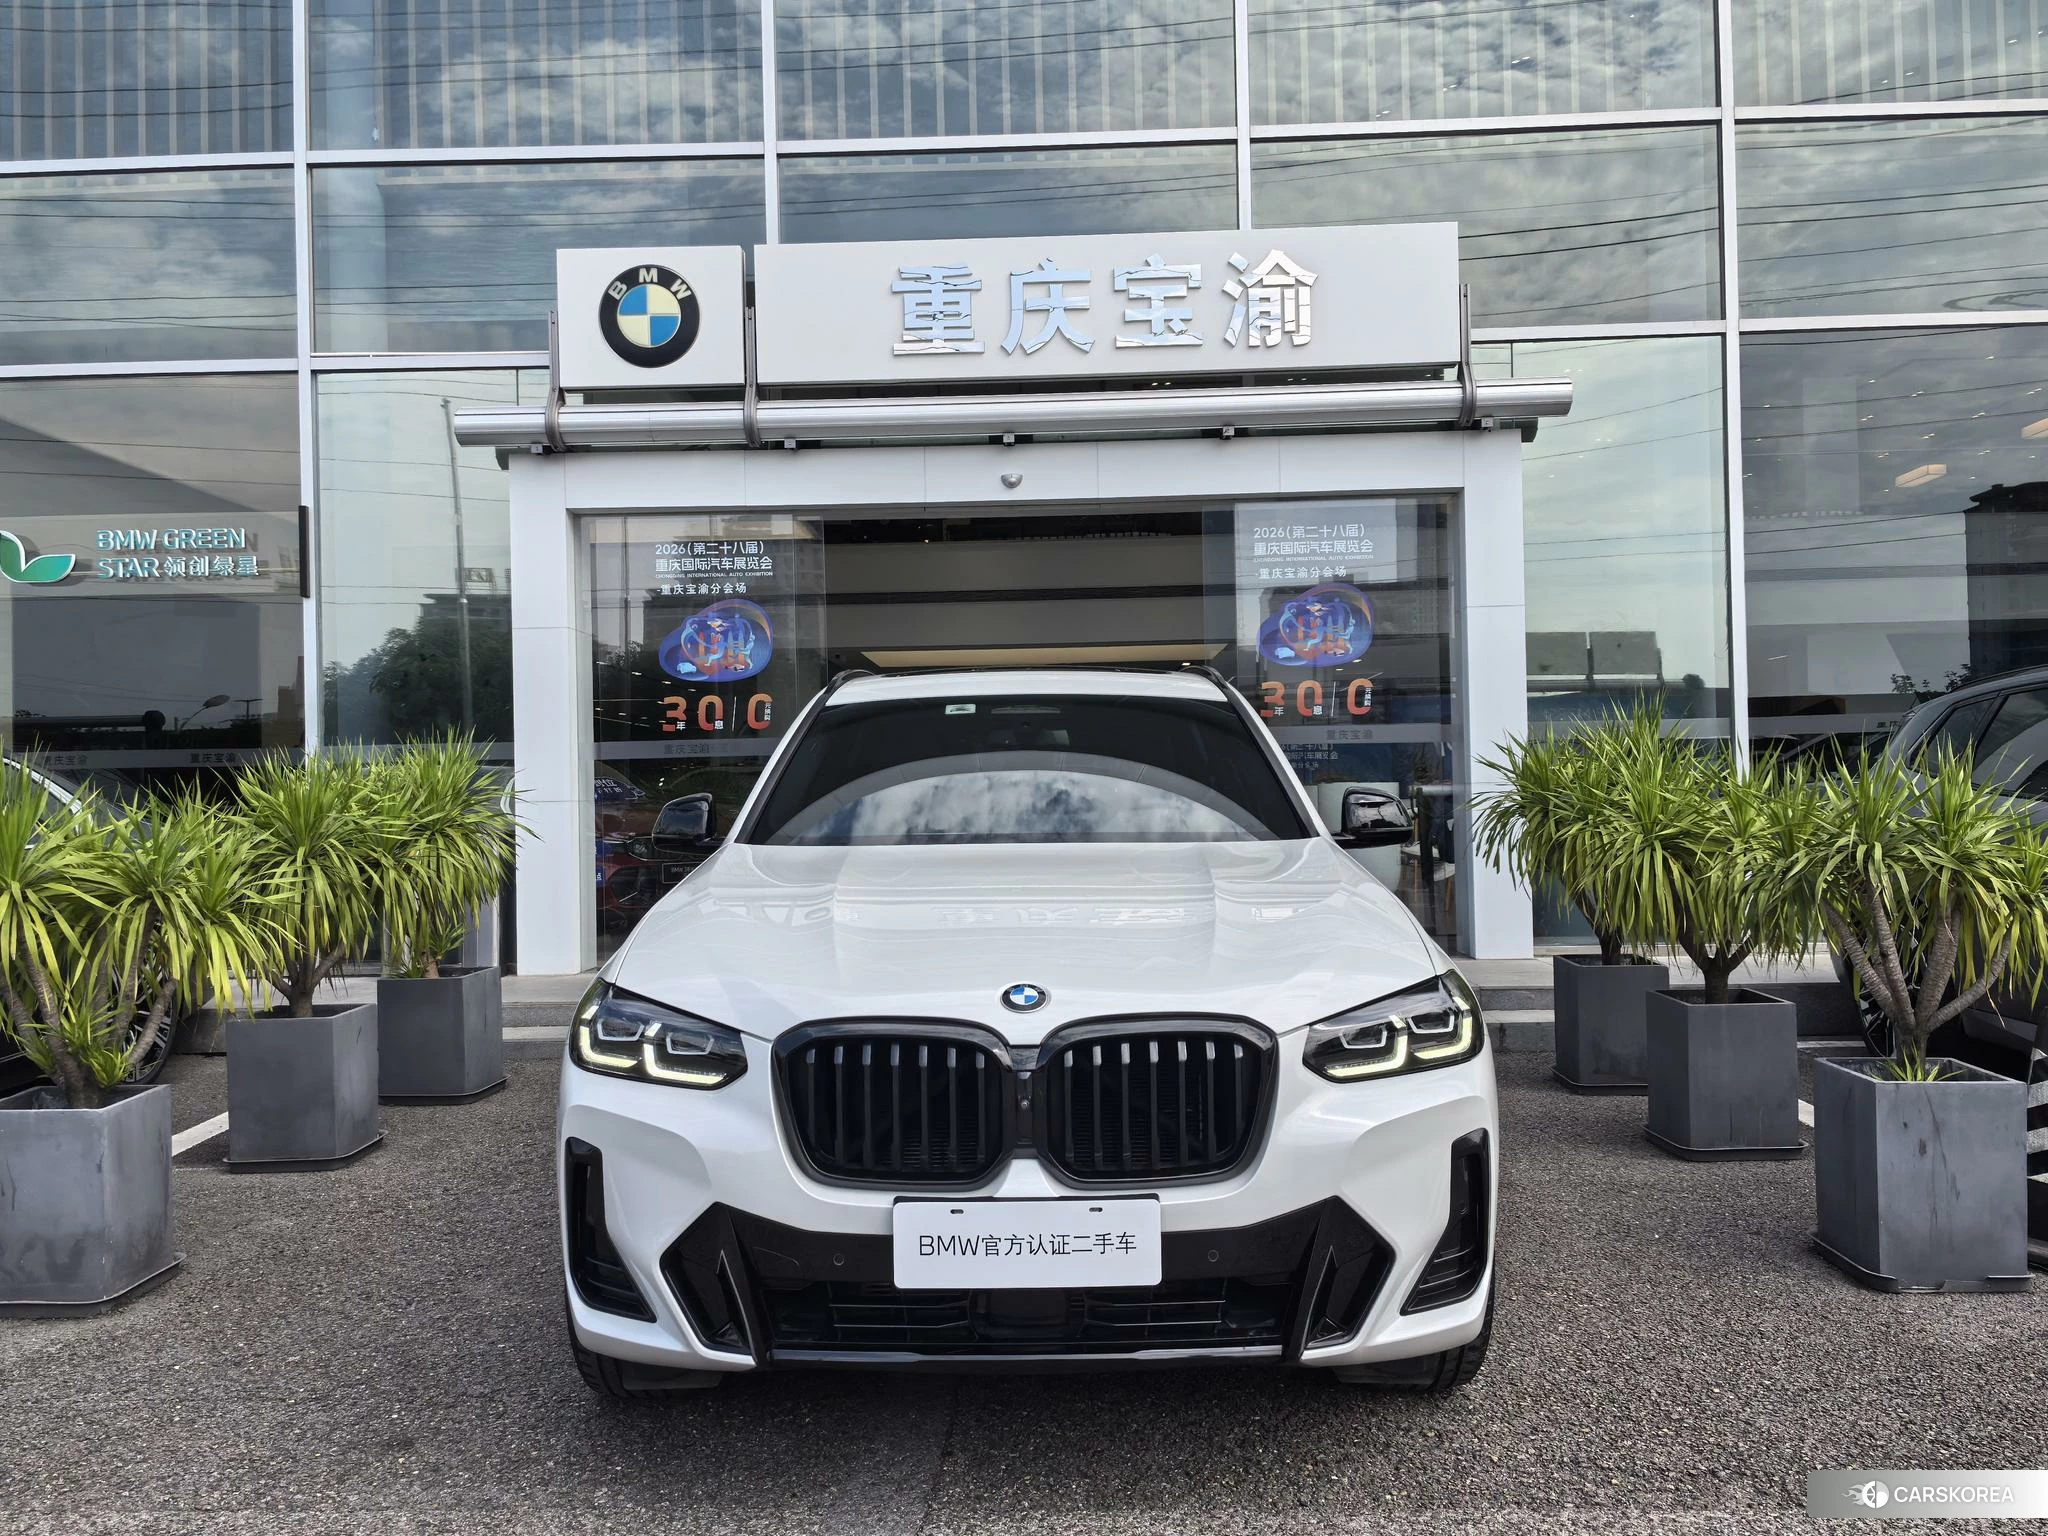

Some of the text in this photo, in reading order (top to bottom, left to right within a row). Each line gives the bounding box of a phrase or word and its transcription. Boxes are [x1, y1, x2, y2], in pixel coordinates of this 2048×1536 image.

[608, 267, 692, 301] BMW
[891, 249, 1319, 357] 重庆宝渝
[96, 527, 247, 551] BMW GREEN
[1253, 539, 1374, 556] 重庆国际汽车展览会
[96, 555, 259, 580] STAR 领创绿星
[655, 555, 773, 572] 重庆国际汽车展览会
[918, 1231, 1137, 1257] BMW官方认证二手车
